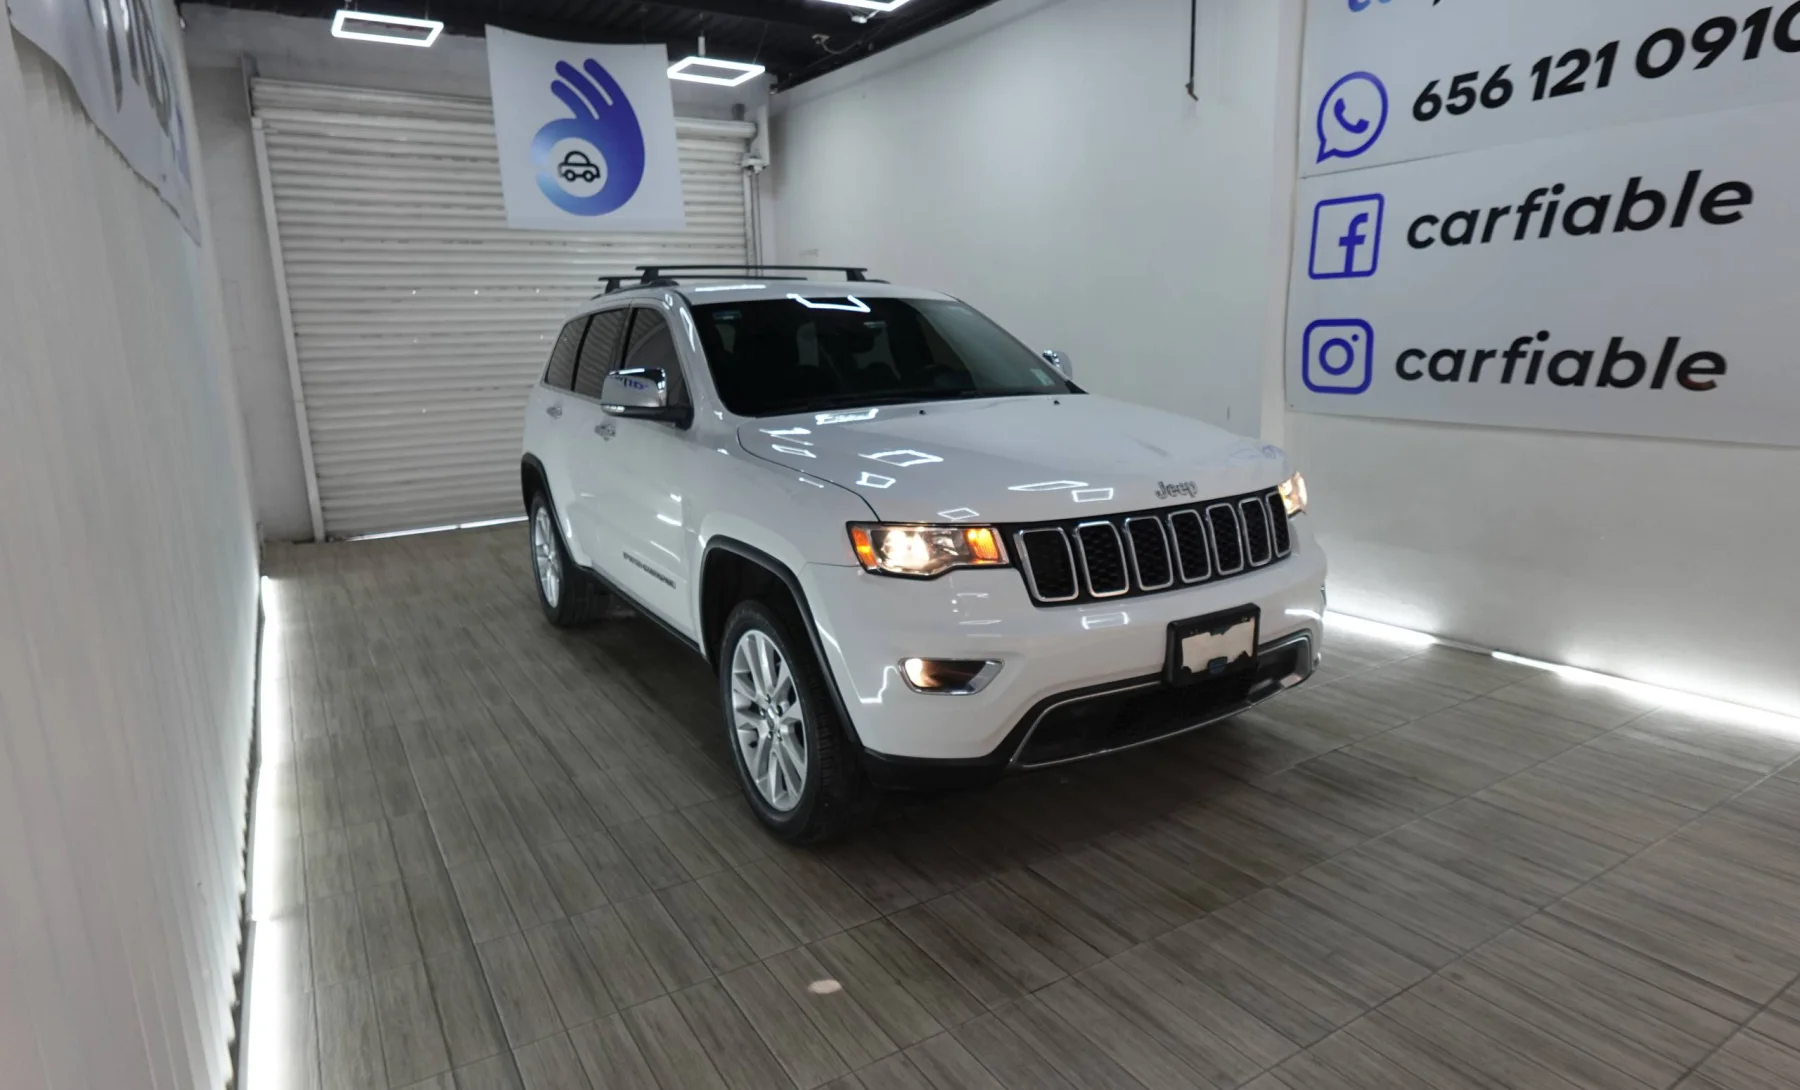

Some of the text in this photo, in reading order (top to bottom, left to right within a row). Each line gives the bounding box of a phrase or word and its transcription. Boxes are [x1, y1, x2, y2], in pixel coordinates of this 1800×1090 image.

[1412, 64, 1514, 122] 656
[1531, 40, 1620, 101] 121
[1407, 169, 1753, 249] carfiable
[1395, 330, 1727, 392] carfiable
[1155, 481, 1198, 499] Jeep
